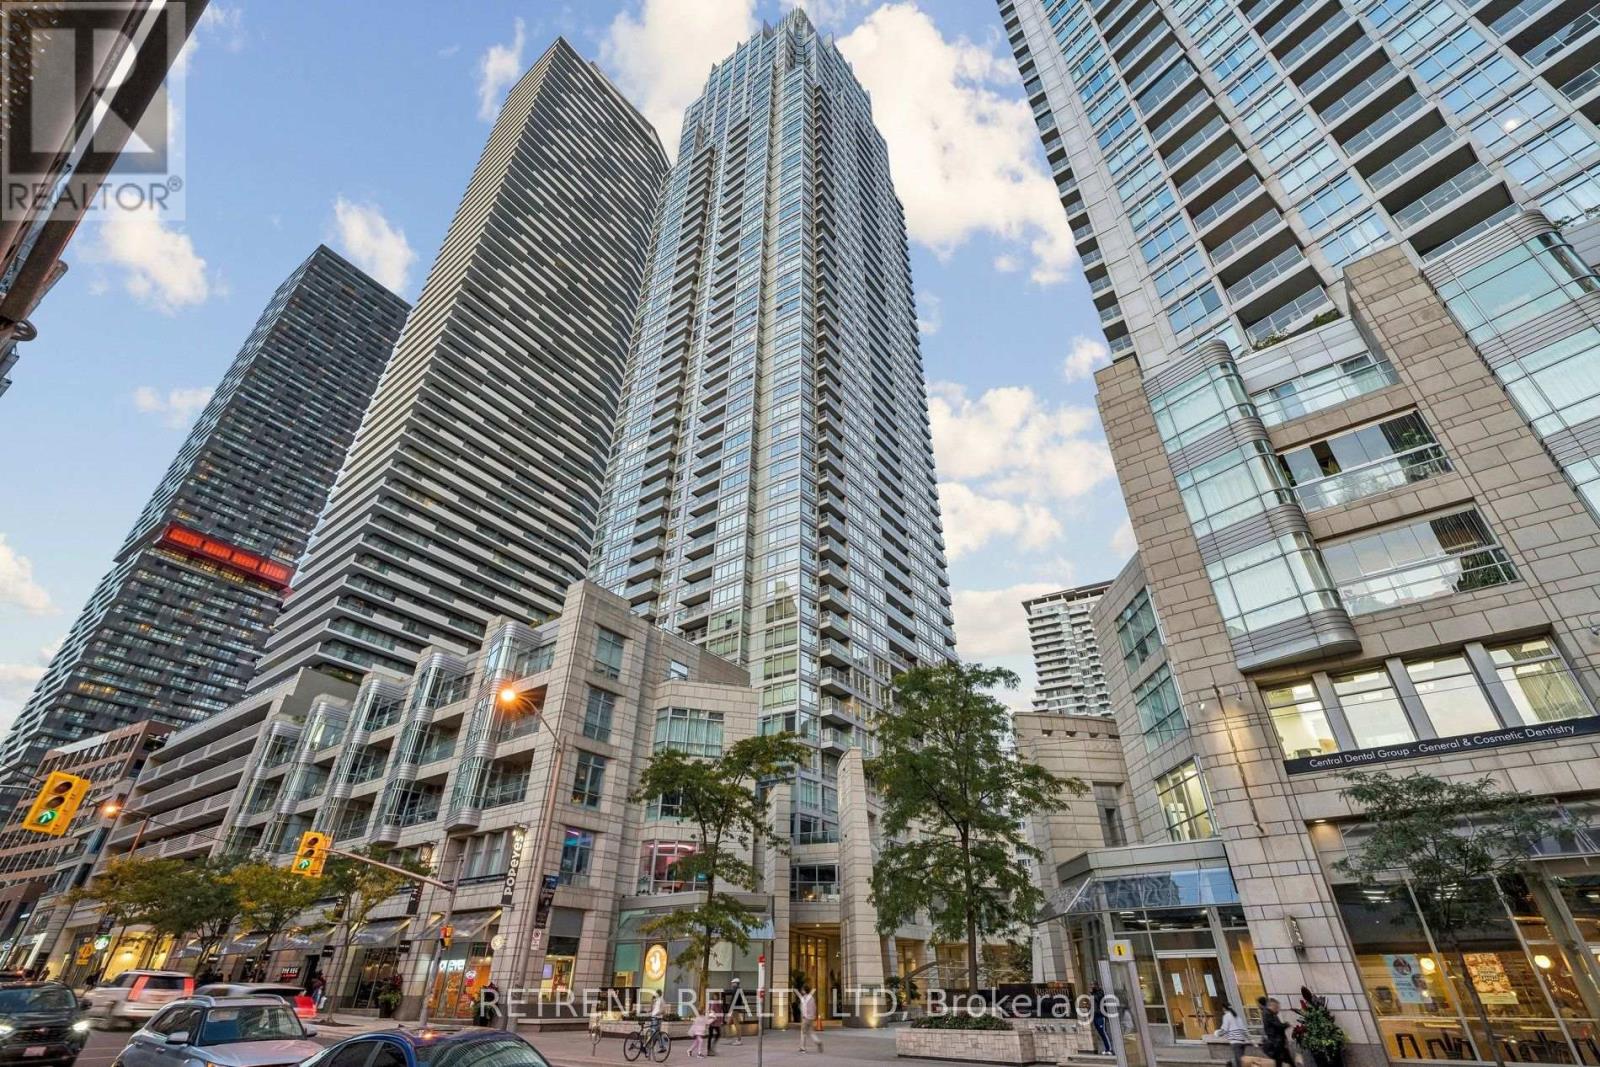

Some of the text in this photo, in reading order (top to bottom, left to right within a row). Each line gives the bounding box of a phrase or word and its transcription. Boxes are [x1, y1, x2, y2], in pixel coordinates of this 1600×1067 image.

[1309, 757, 1342, 768] Central
[1344, 752, 1375, 763] Dental
[1378, 749, 1410, 759] Group
[1418, 740, 1460, 753] General
[1462, 738, 1472, 747] &
[1473, 731, 1524, 745] Cosmetic
[1524, 725, 1575, 738] Dentistry
